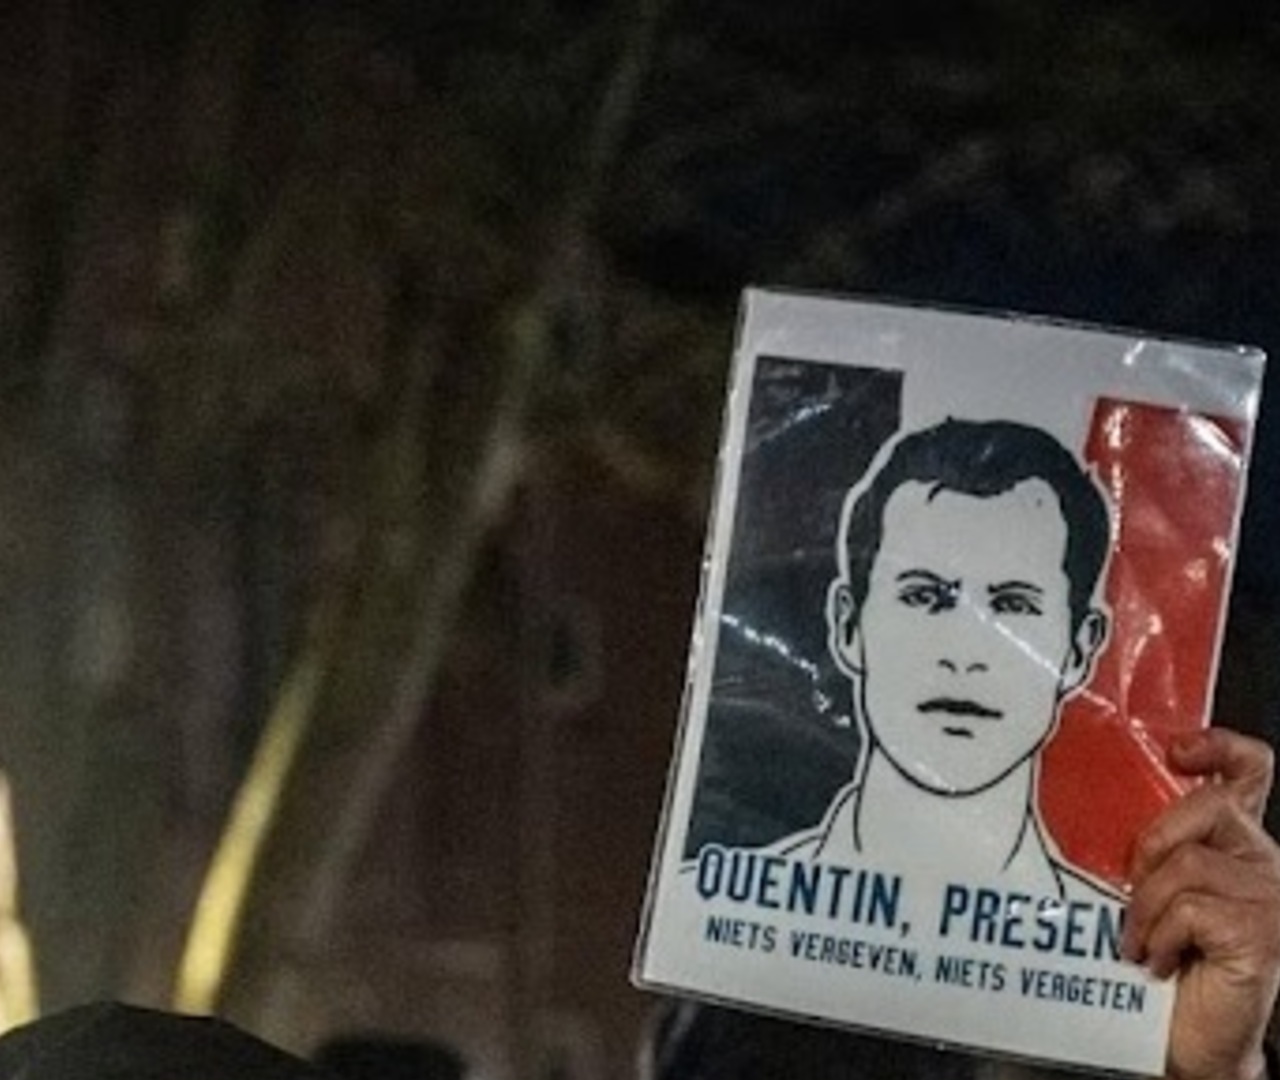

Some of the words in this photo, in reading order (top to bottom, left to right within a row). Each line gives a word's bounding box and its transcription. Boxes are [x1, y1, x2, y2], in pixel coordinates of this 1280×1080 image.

[696, 846, 911, 938] QUENTIN,
[938, 884, 1126, 961] PRESEN
[705, 915, 778, 953] NIETS
[790, 929, 923, 984] VERGEVEN,
[934, 955, 1006, 992] NIETS
[1020, 967, 1147, 1013] VERGETEN
